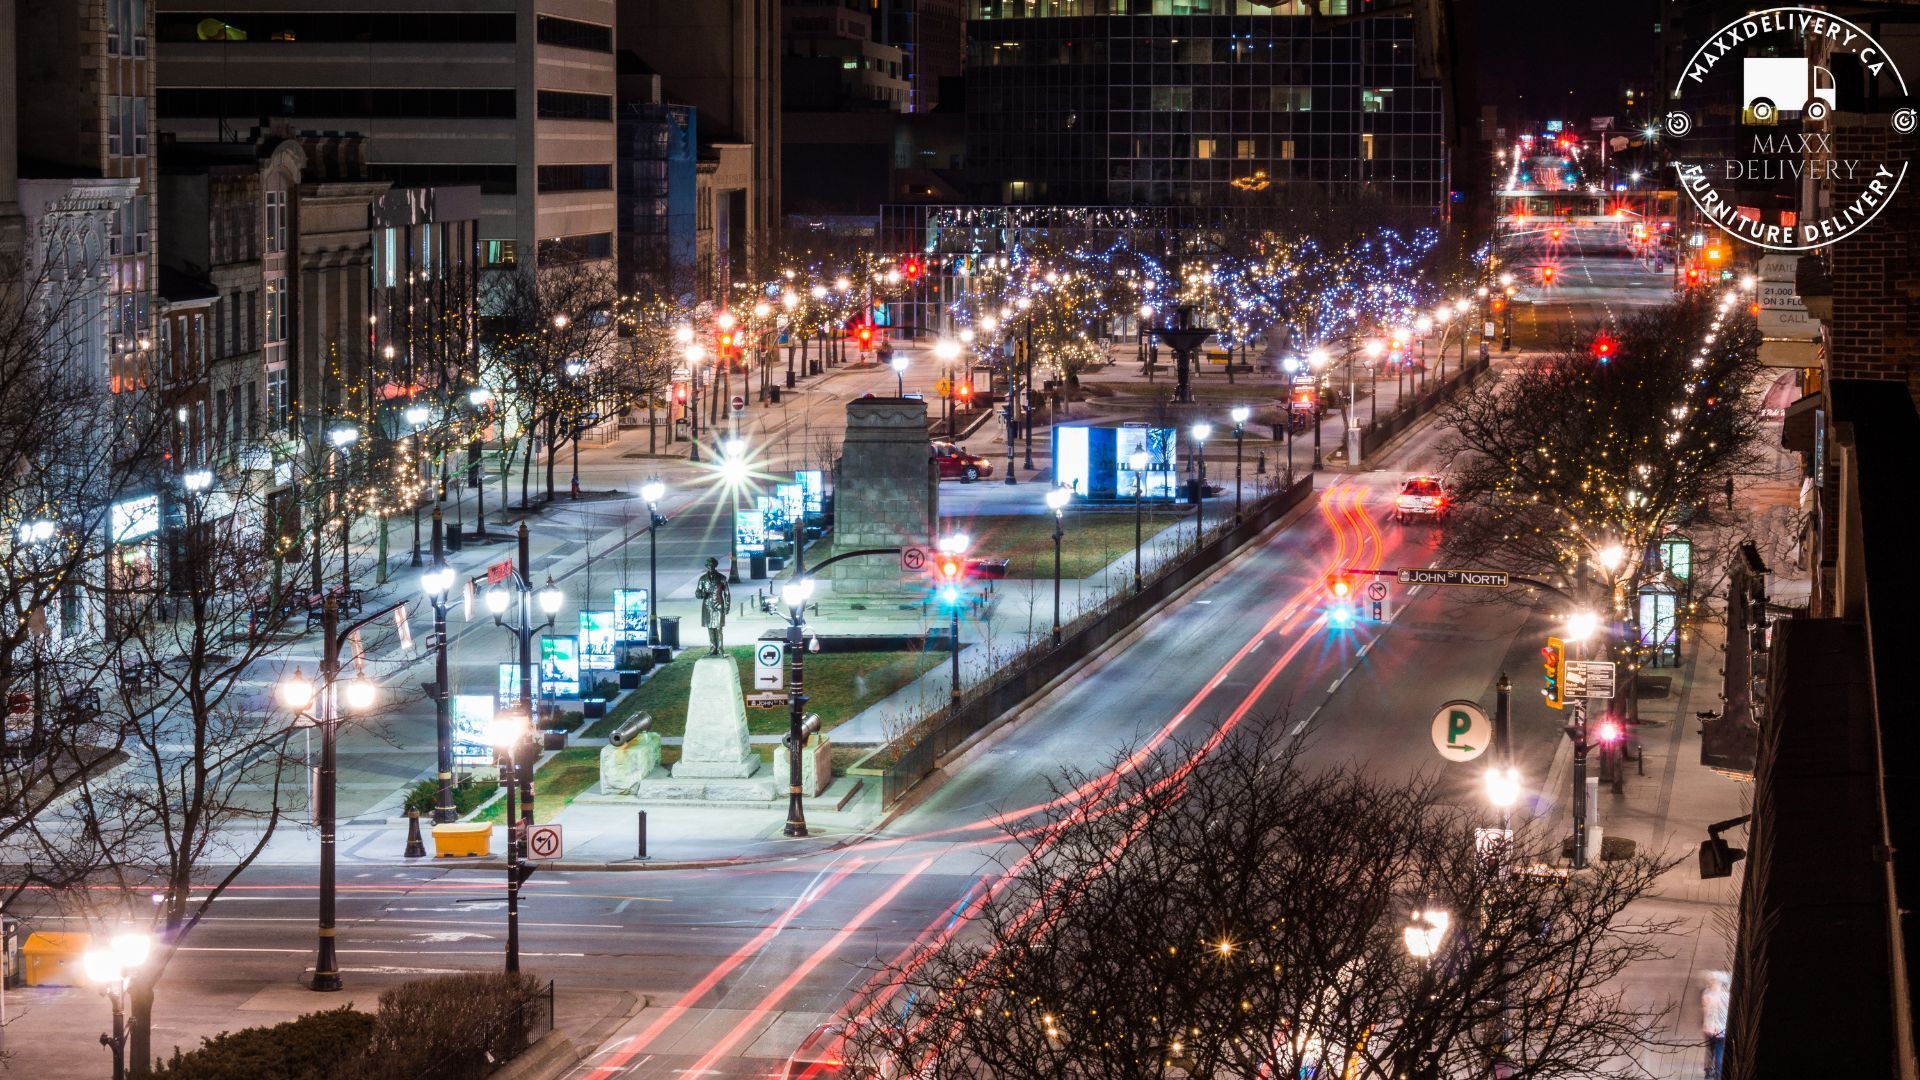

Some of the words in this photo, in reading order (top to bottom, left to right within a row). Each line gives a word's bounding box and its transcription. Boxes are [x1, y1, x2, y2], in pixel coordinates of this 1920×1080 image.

[1763, 298, 1777, 306] ON
[1780, 298, 1785, 306] 3
[1780, 314, 1807, 323] CALL
[1448, 711, 1472, 744] P
